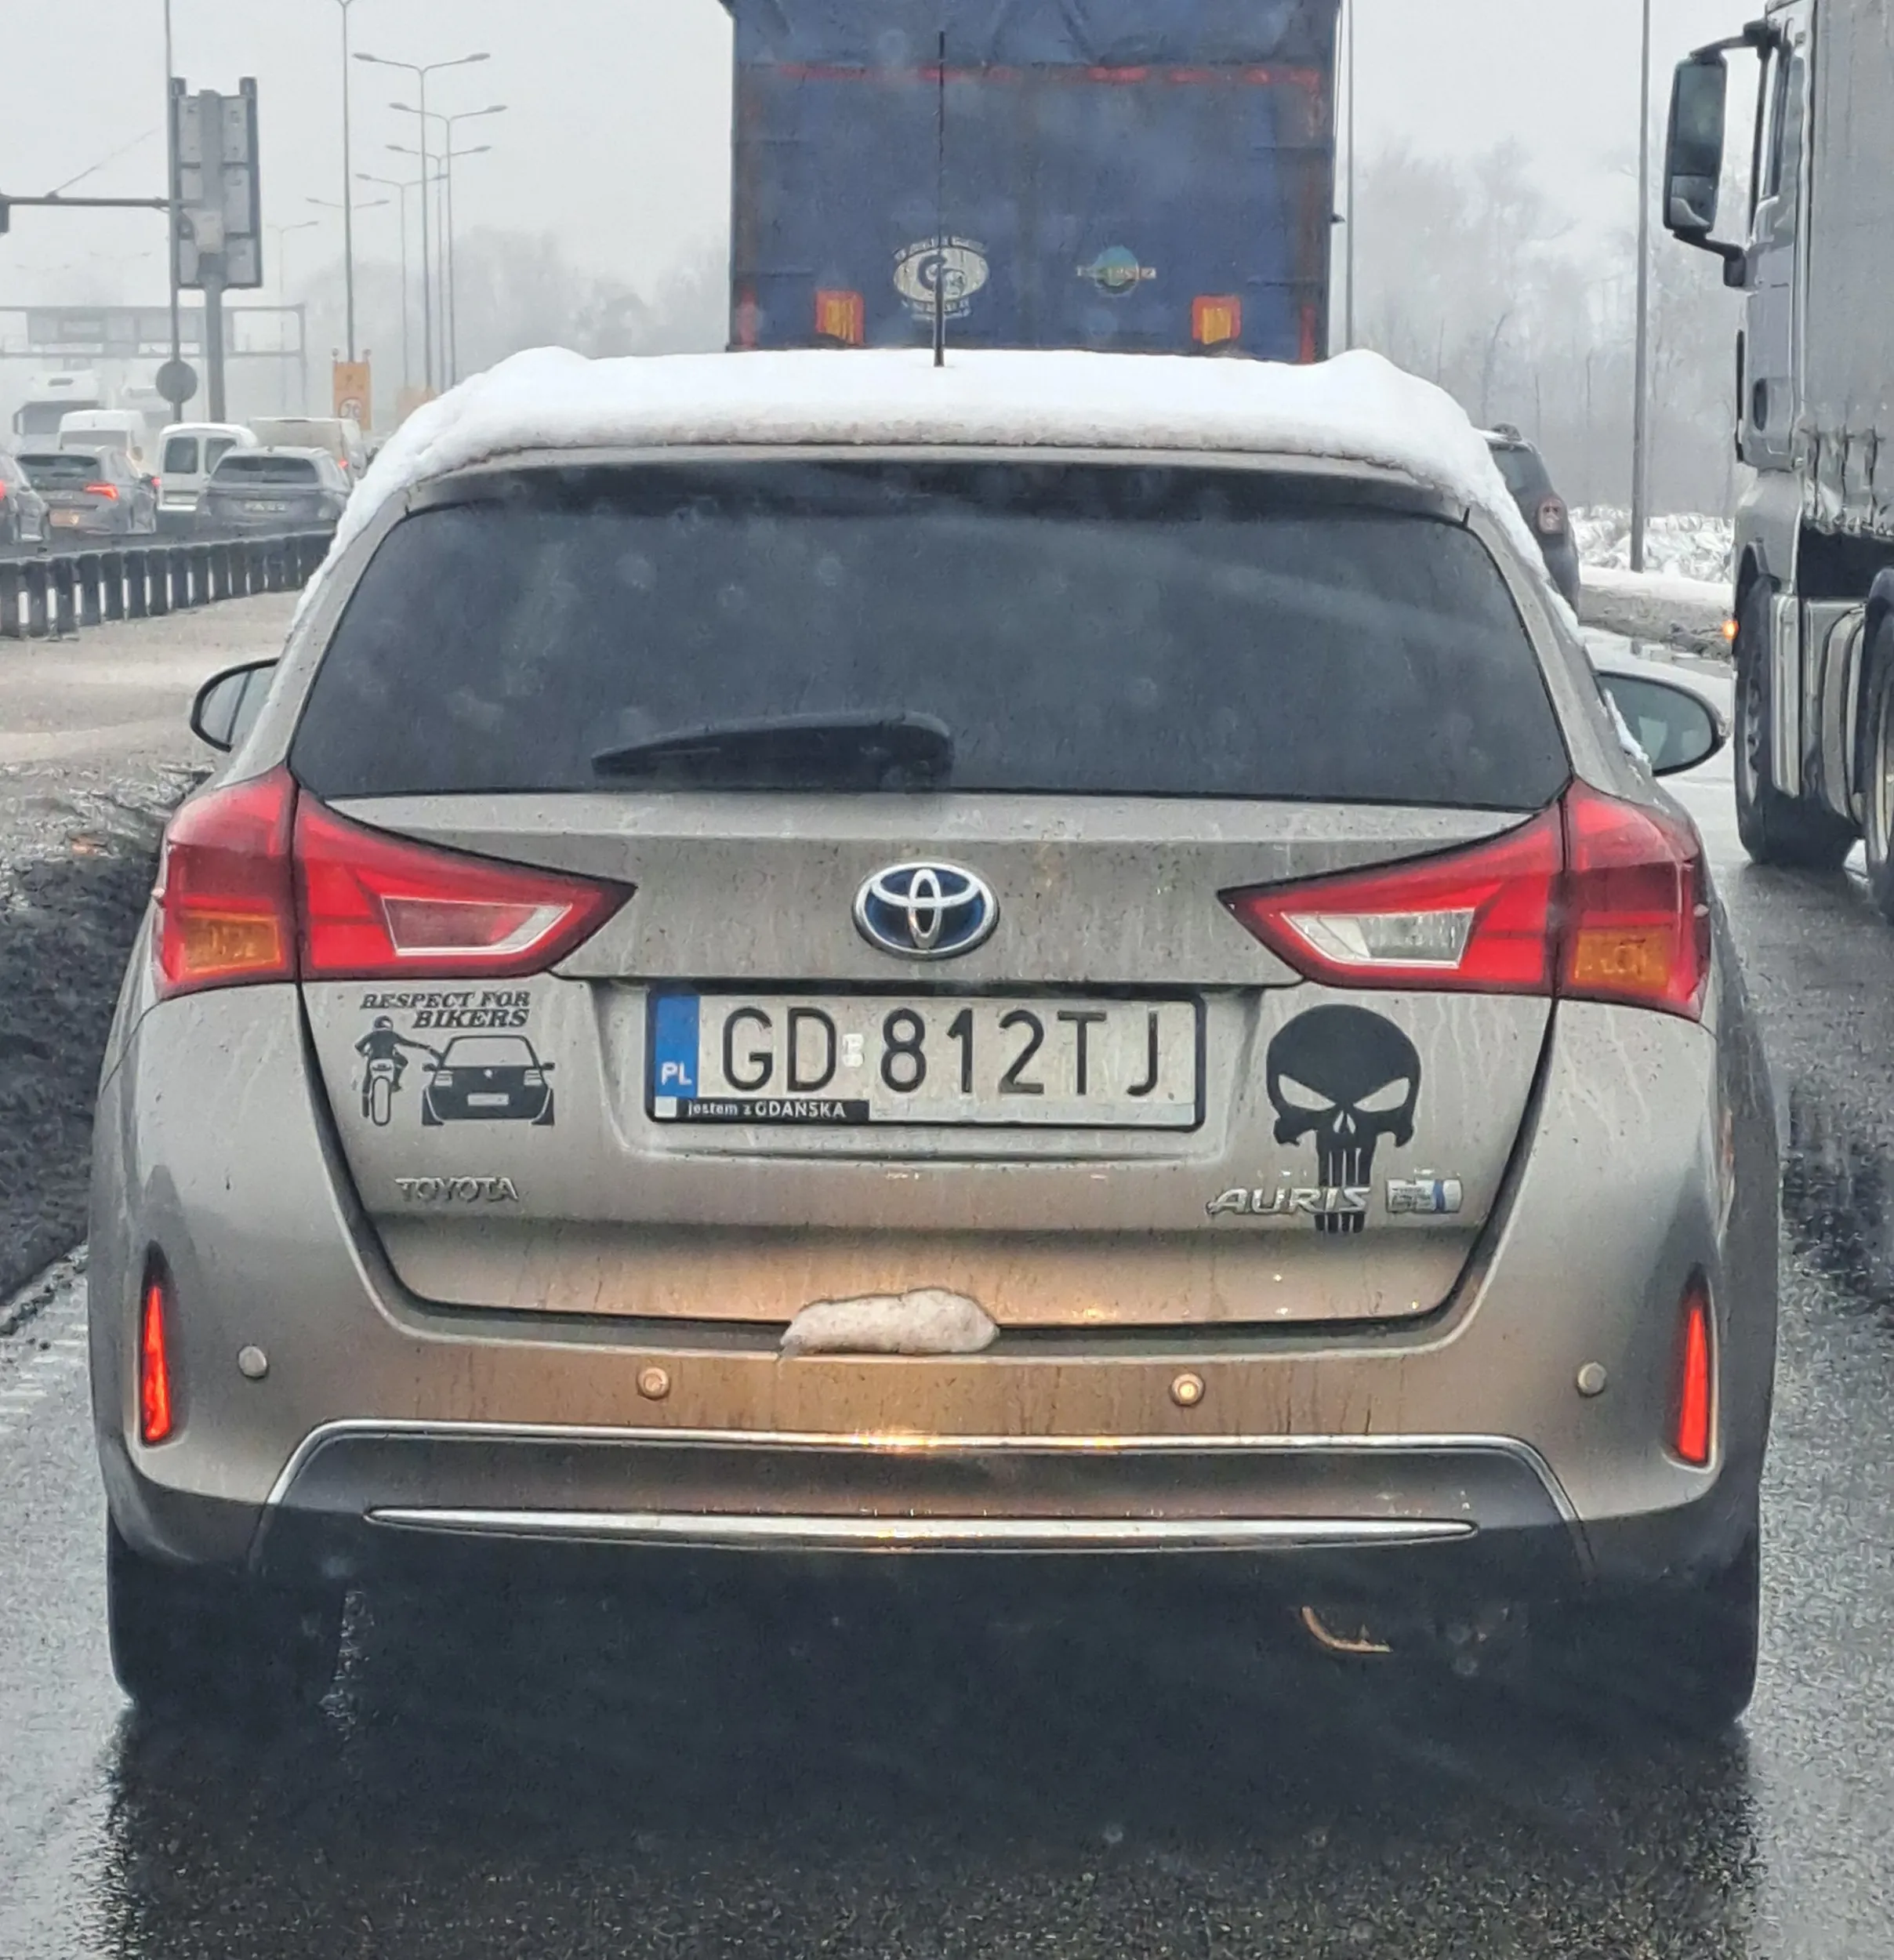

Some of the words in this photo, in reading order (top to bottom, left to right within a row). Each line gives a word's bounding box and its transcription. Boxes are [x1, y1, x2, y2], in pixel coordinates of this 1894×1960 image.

[360, 992, 474, 1009] RESPECT
[479, 991, 531, 1007] FOR
[412, 1009, 529, 1029] BIKERS
[721, 1007, 836, 1092] GD
[880, 1008, 1159, 1097] 812TJ
[661, 1062, 692, 1086] PL
[688, 1102, 738, 1117] jestem
[744, 1106, 752, 1116] z
[394, 1177, 518, 1203] TOYOTA
[1206, 1186, 1371, 1214] AURIS
